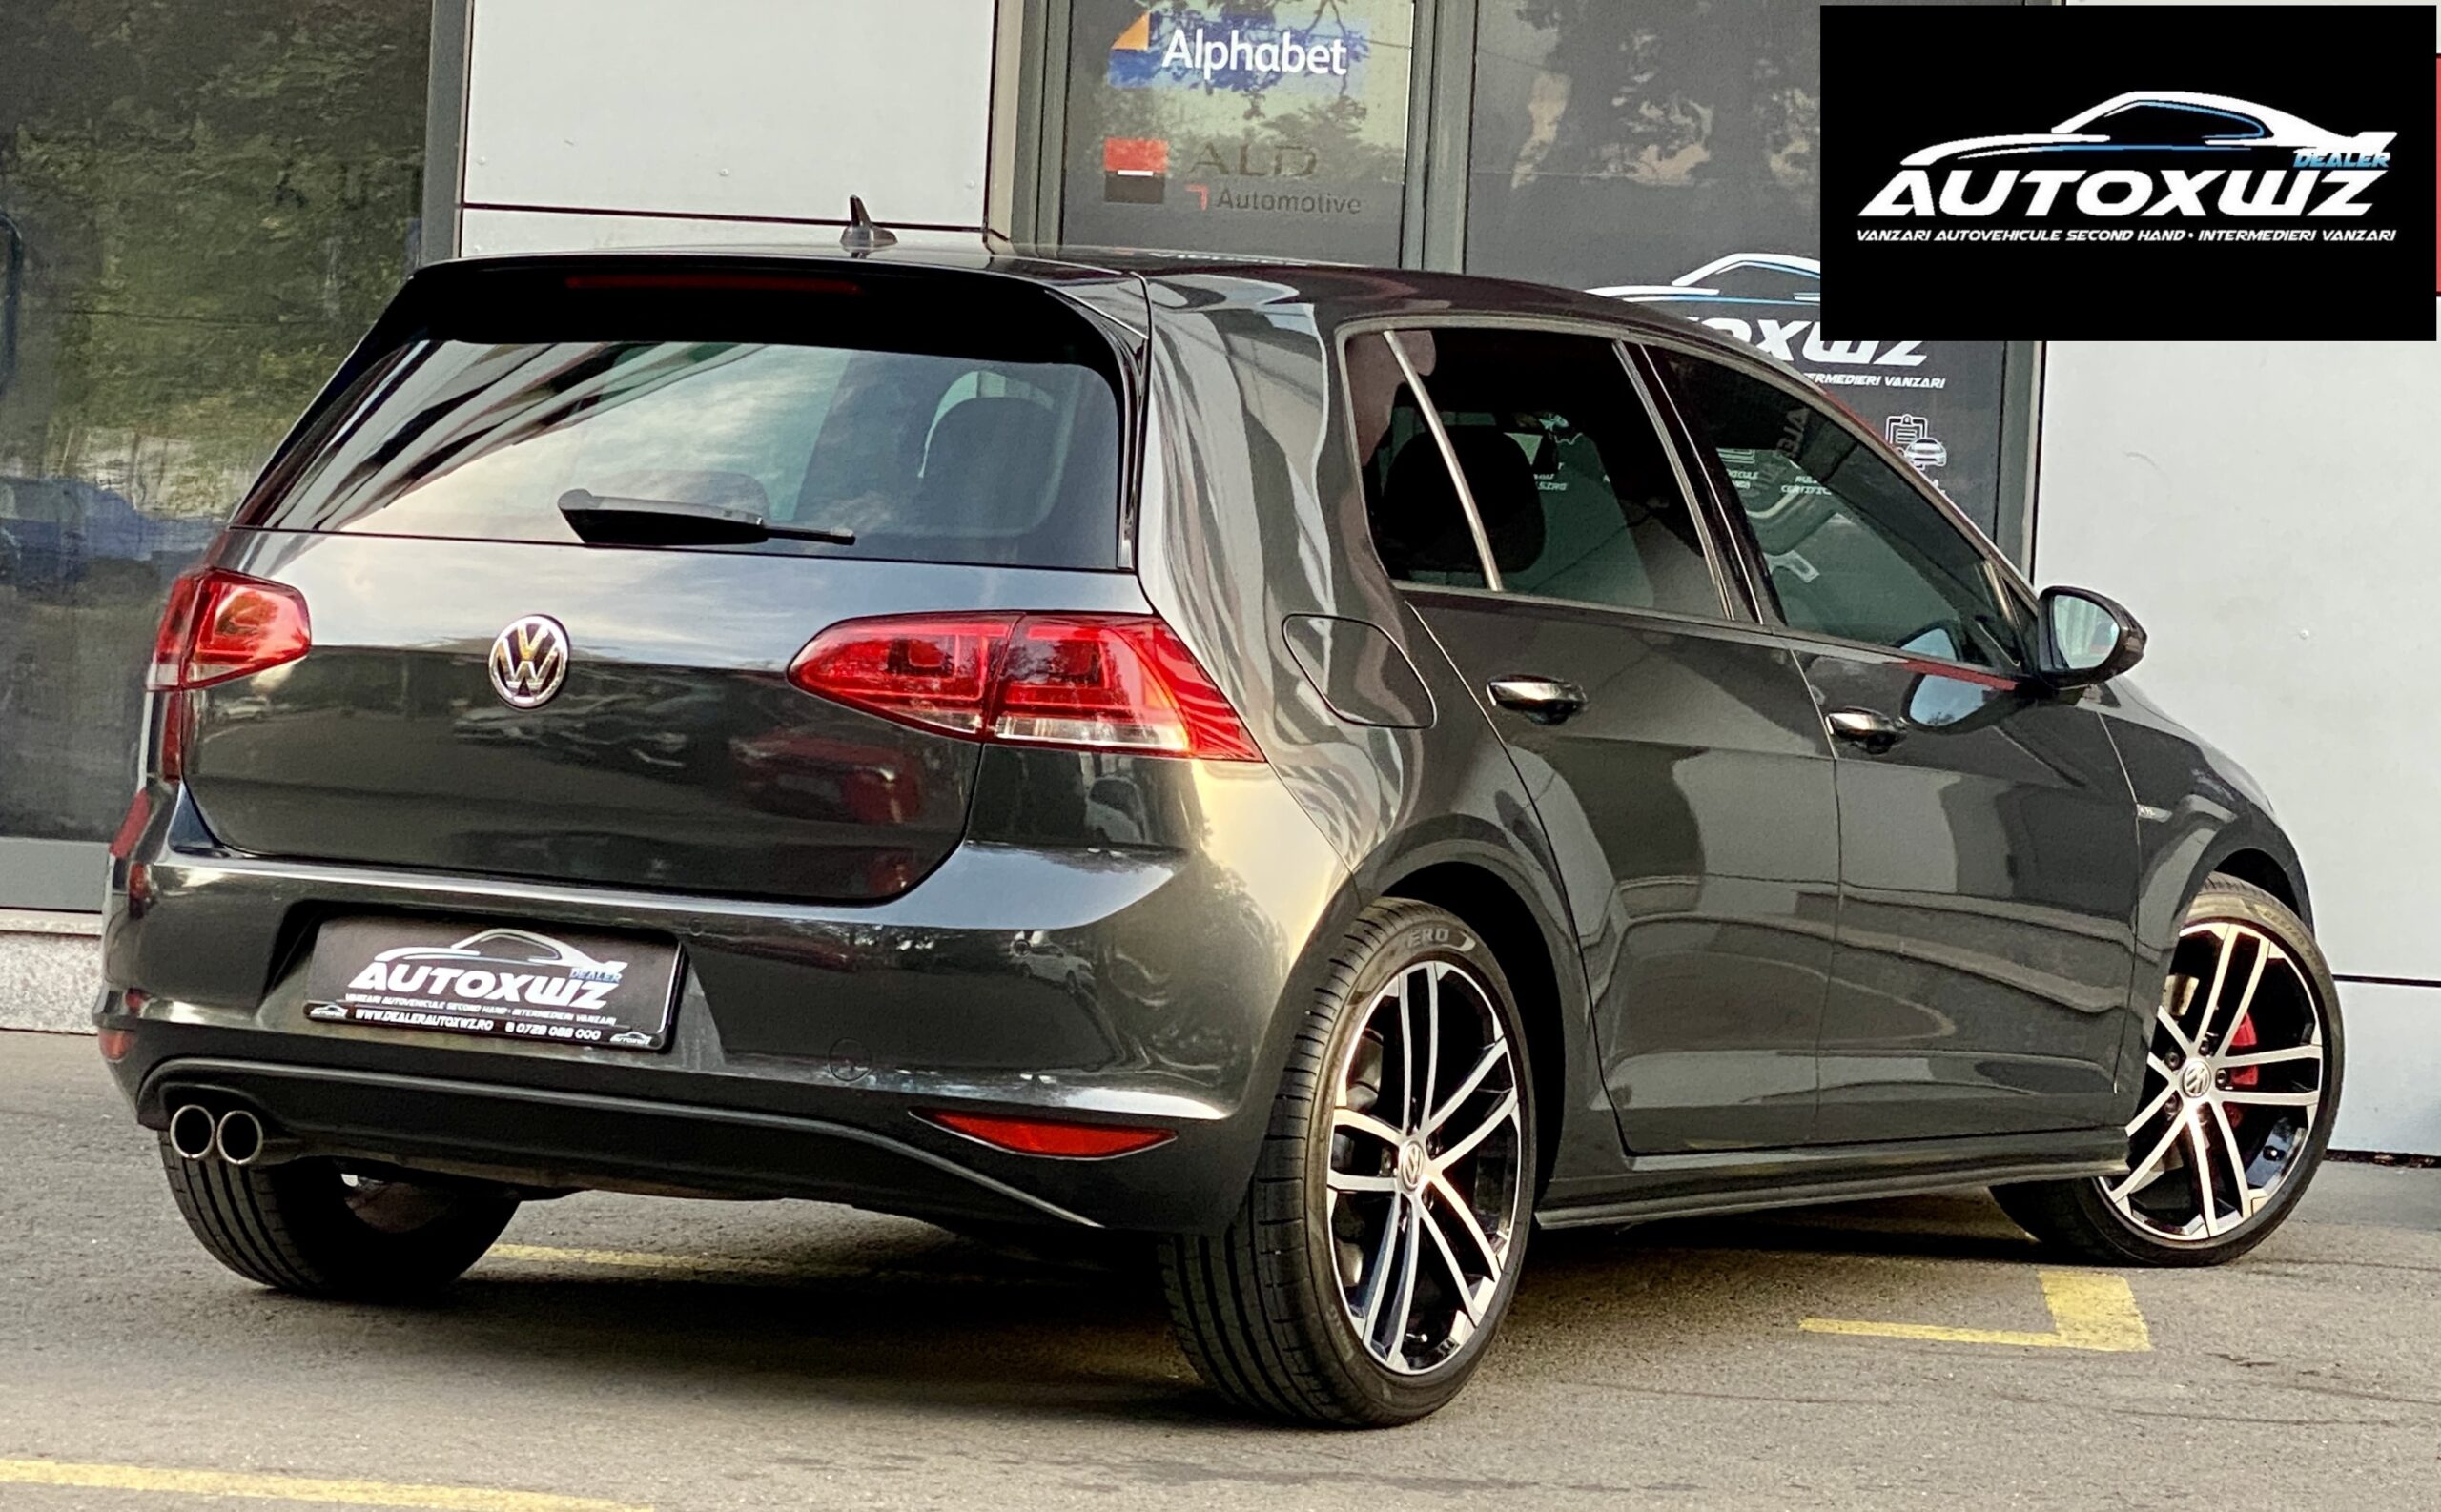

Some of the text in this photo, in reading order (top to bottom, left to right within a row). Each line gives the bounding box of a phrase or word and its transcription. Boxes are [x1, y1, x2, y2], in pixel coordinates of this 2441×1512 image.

[1161, 28, 1347, 80] Alphabet
[1191, 142, 1318, 177] ALD
[1217, 189, 1362, 215] Automotive
[1884, 375, 1947, 389] VANZARI
[347, 961, 620, 1010] AUTOXWZ
[569, 968, 623, 984] DEALER
[355, 1008, 495, 1032] WWW.DEALERAUTOXWZ.RO
[445, 1002, 482, 1013] SECOND
